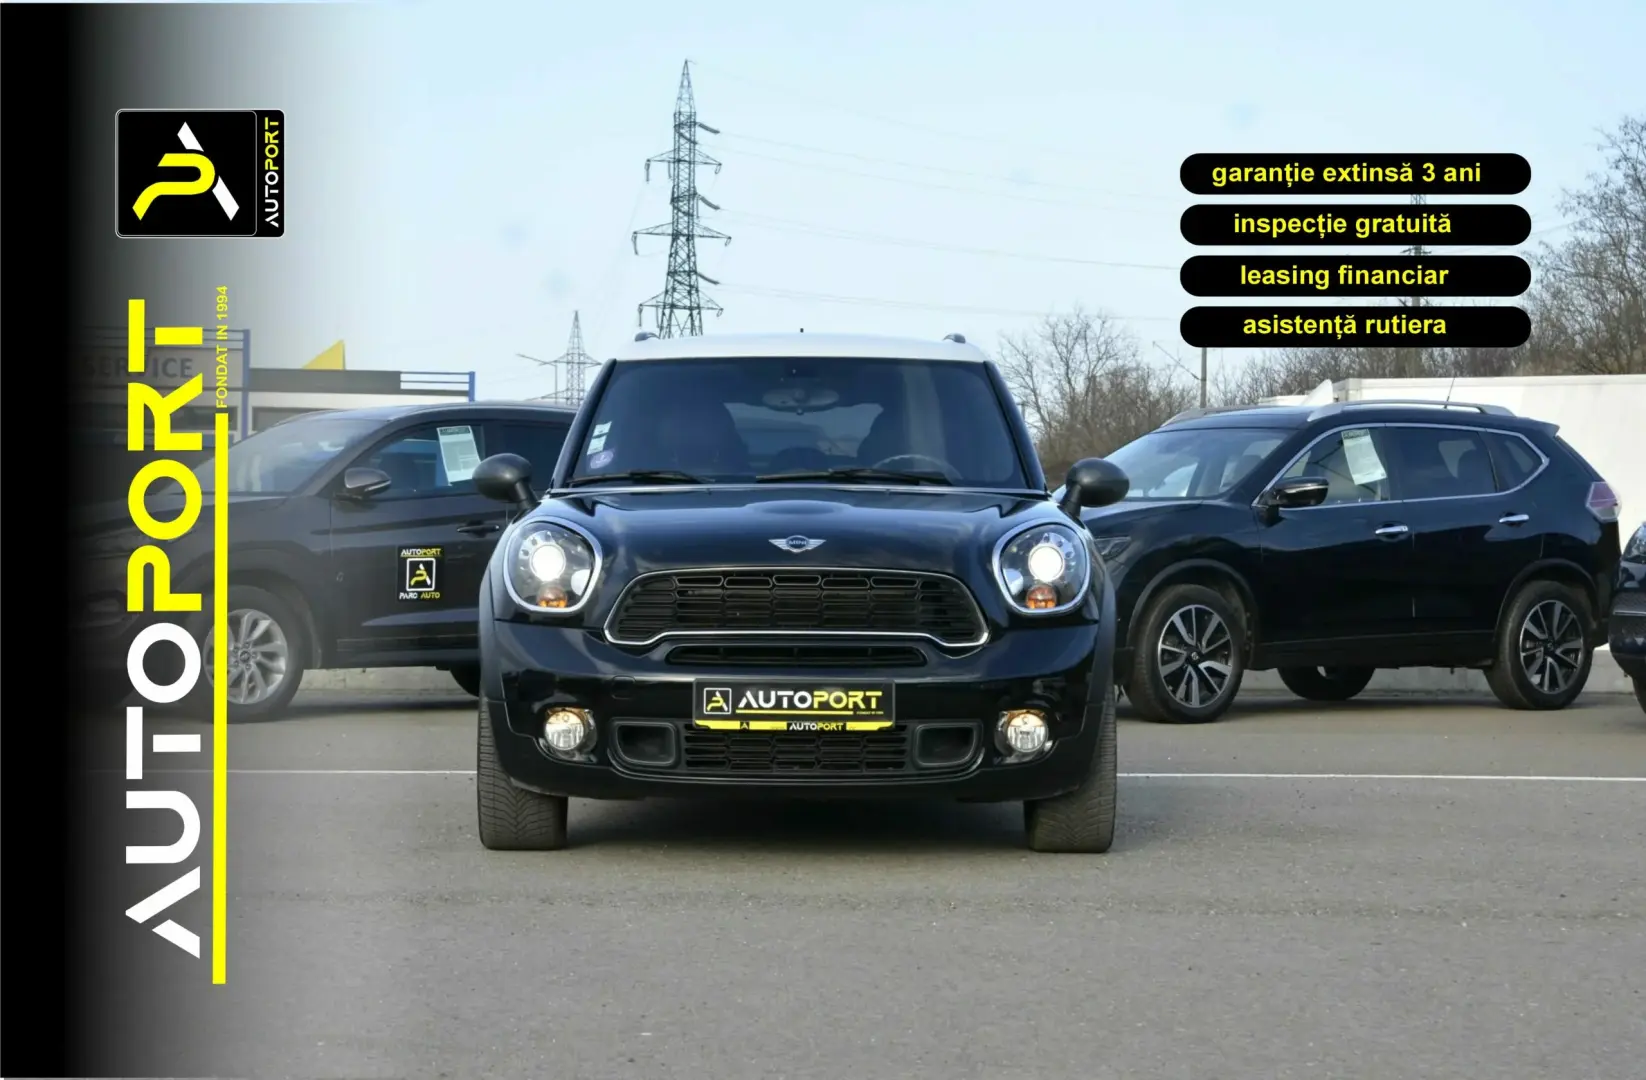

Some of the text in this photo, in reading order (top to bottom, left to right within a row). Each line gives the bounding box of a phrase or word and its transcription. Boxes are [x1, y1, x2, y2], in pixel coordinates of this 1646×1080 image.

[401, 548, 441, 556] AUTOPORT
[738, 690, 883, 709] AUTOPORT
[789, 720, 844, 731] AUTOPORT
